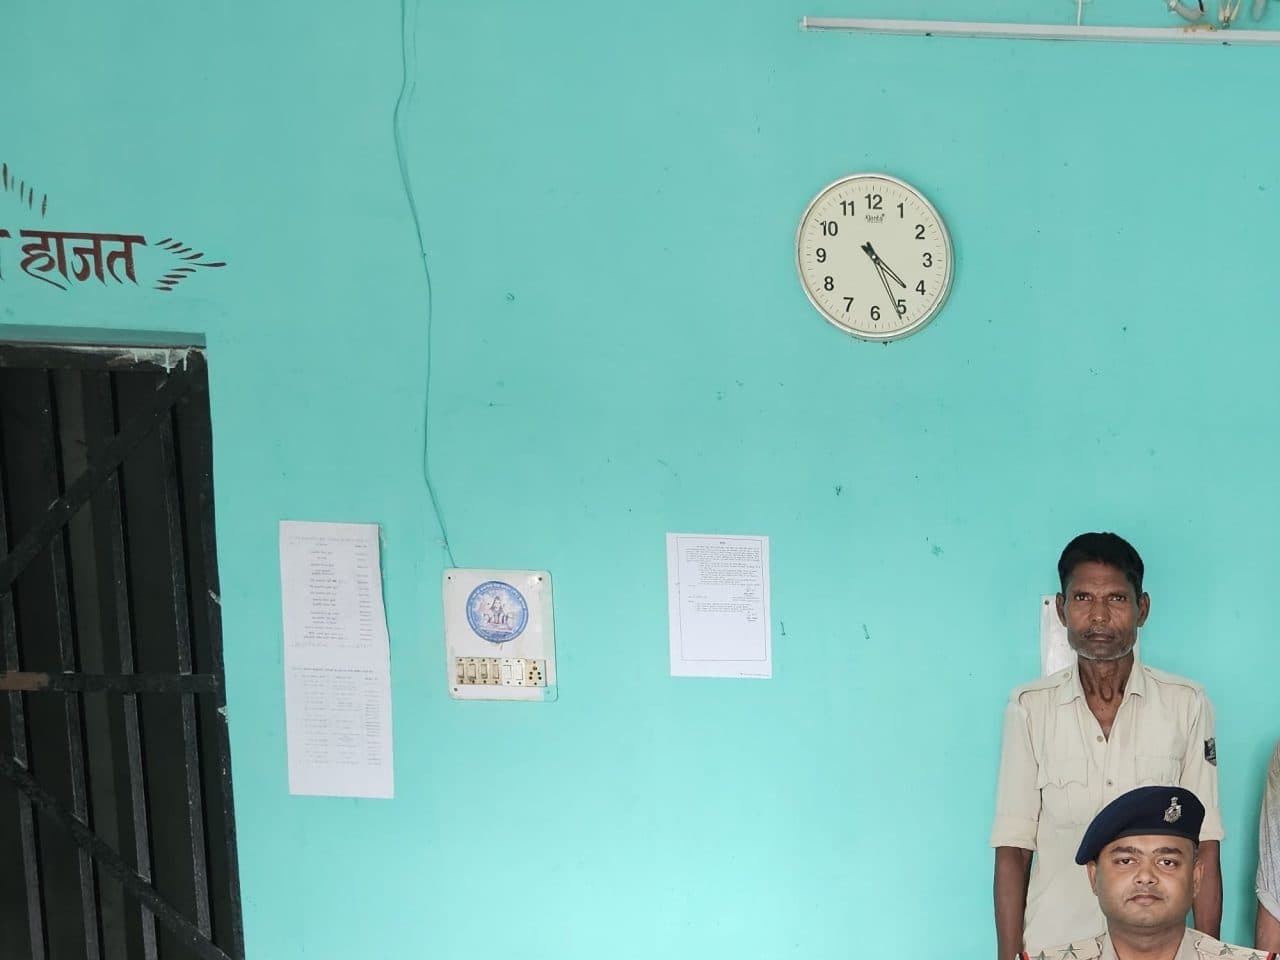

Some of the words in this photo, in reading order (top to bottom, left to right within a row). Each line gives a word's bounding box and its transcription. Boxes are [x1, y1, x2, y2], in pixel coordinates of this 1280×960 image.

[839, 200, 855, 216] 11
[864, 194, 883, 210] 12
[896, 203, 904, 219] 1
[820, 221, 838, 236] 10
[915, 224, 926, 240] 2
[19, 229, 147, 291] हाजत
[816, 247, 827, 263] 9
[922, 252, 933, 268] 3
[824, 275, 834, 291] 8
[915, 279, 926, 296] 4
[843, 297, 854, 313] 7
[870, 305, 881, 321] 6
[896, 299, 907, 315] 5
